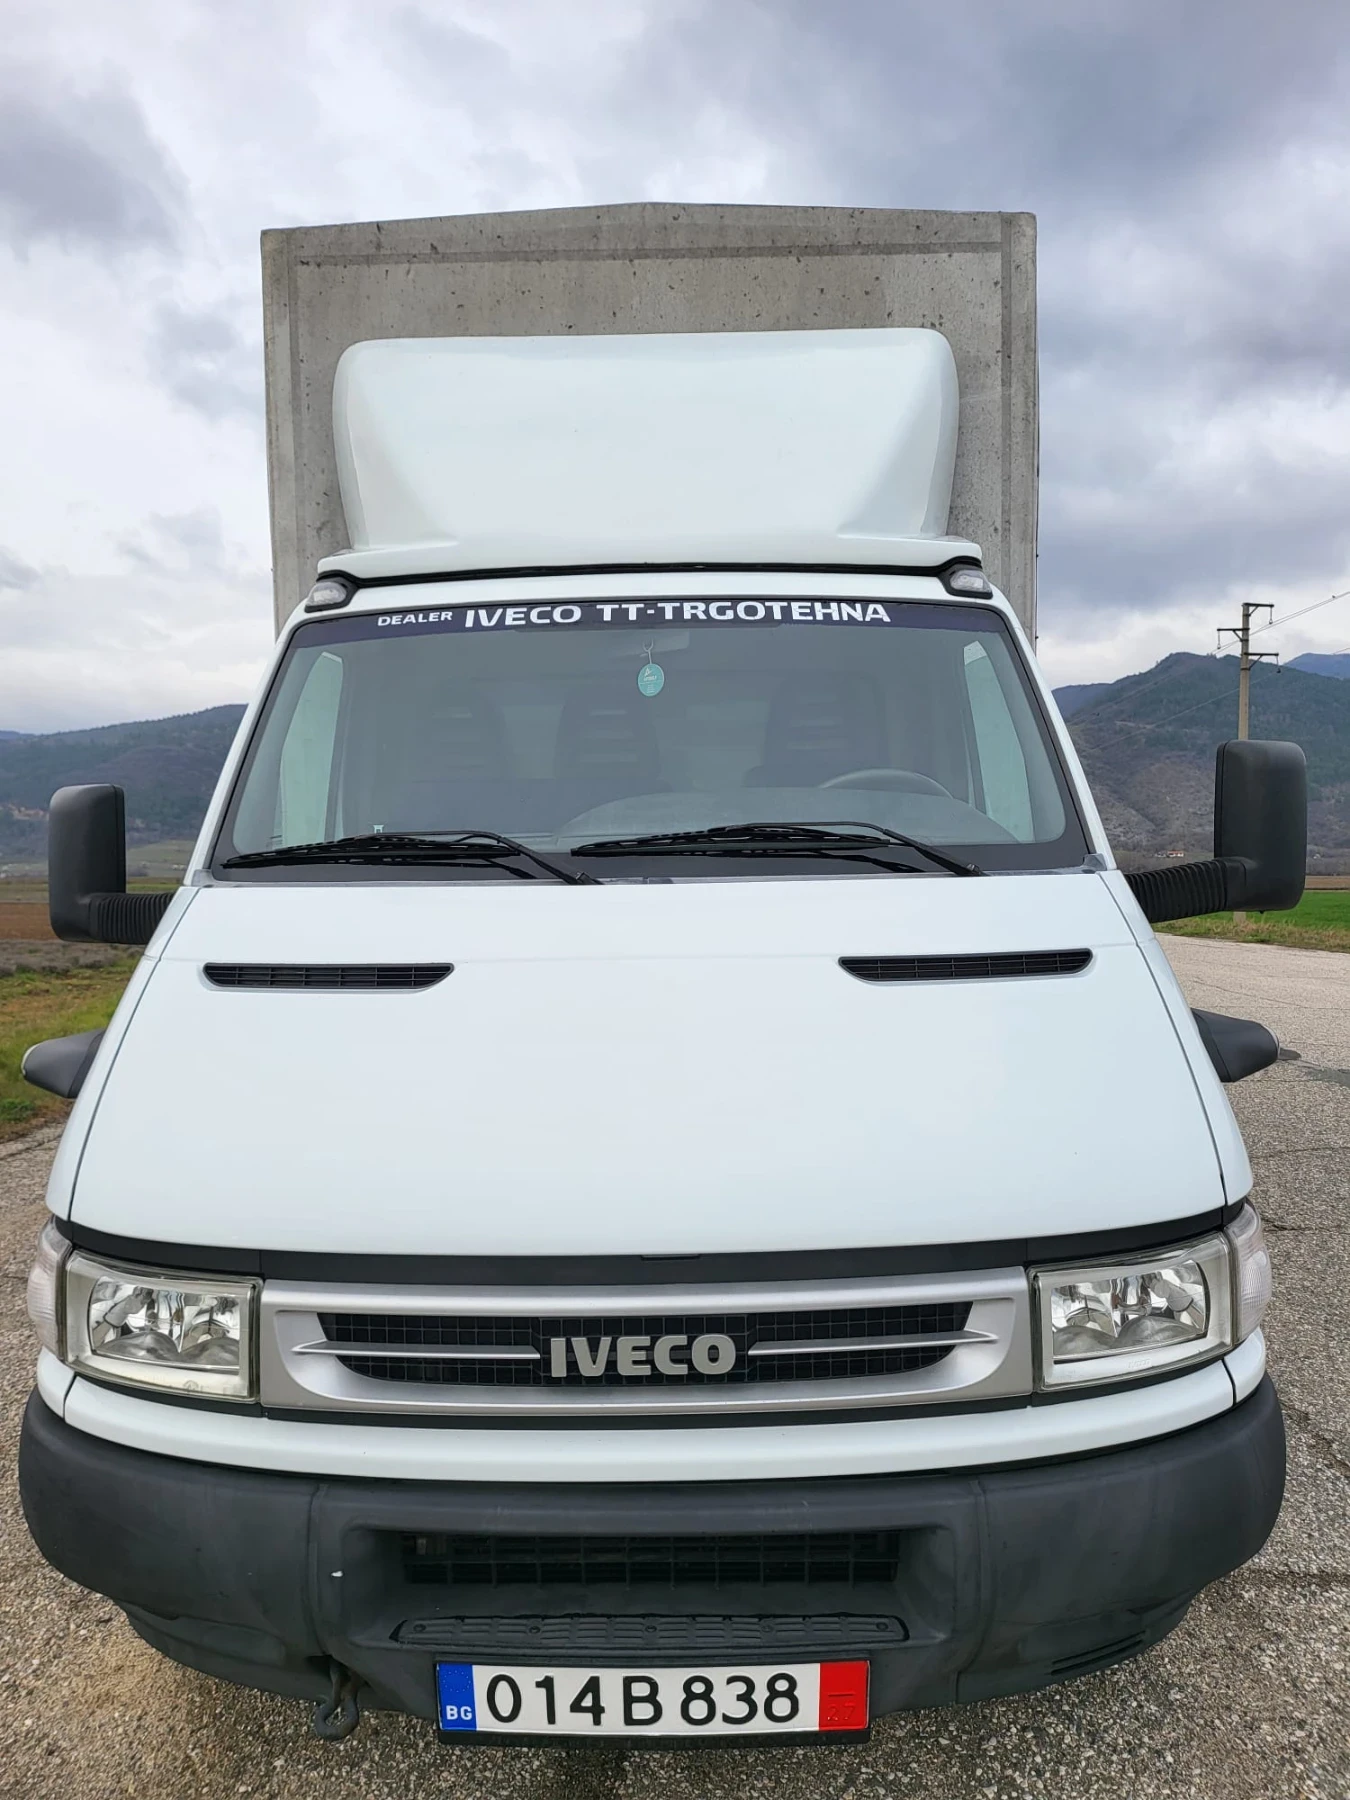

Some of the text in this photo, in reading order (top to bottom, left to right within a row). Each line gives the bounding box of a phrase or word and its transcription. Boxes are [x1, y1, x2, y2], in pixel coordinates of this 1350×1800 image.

[377, 601, 892, 628] DEALER IVECO TT-TRGOTEHNA
[550, 1334, 736, 1378] IVECO
[446, 1705, 473, 1720] BG
